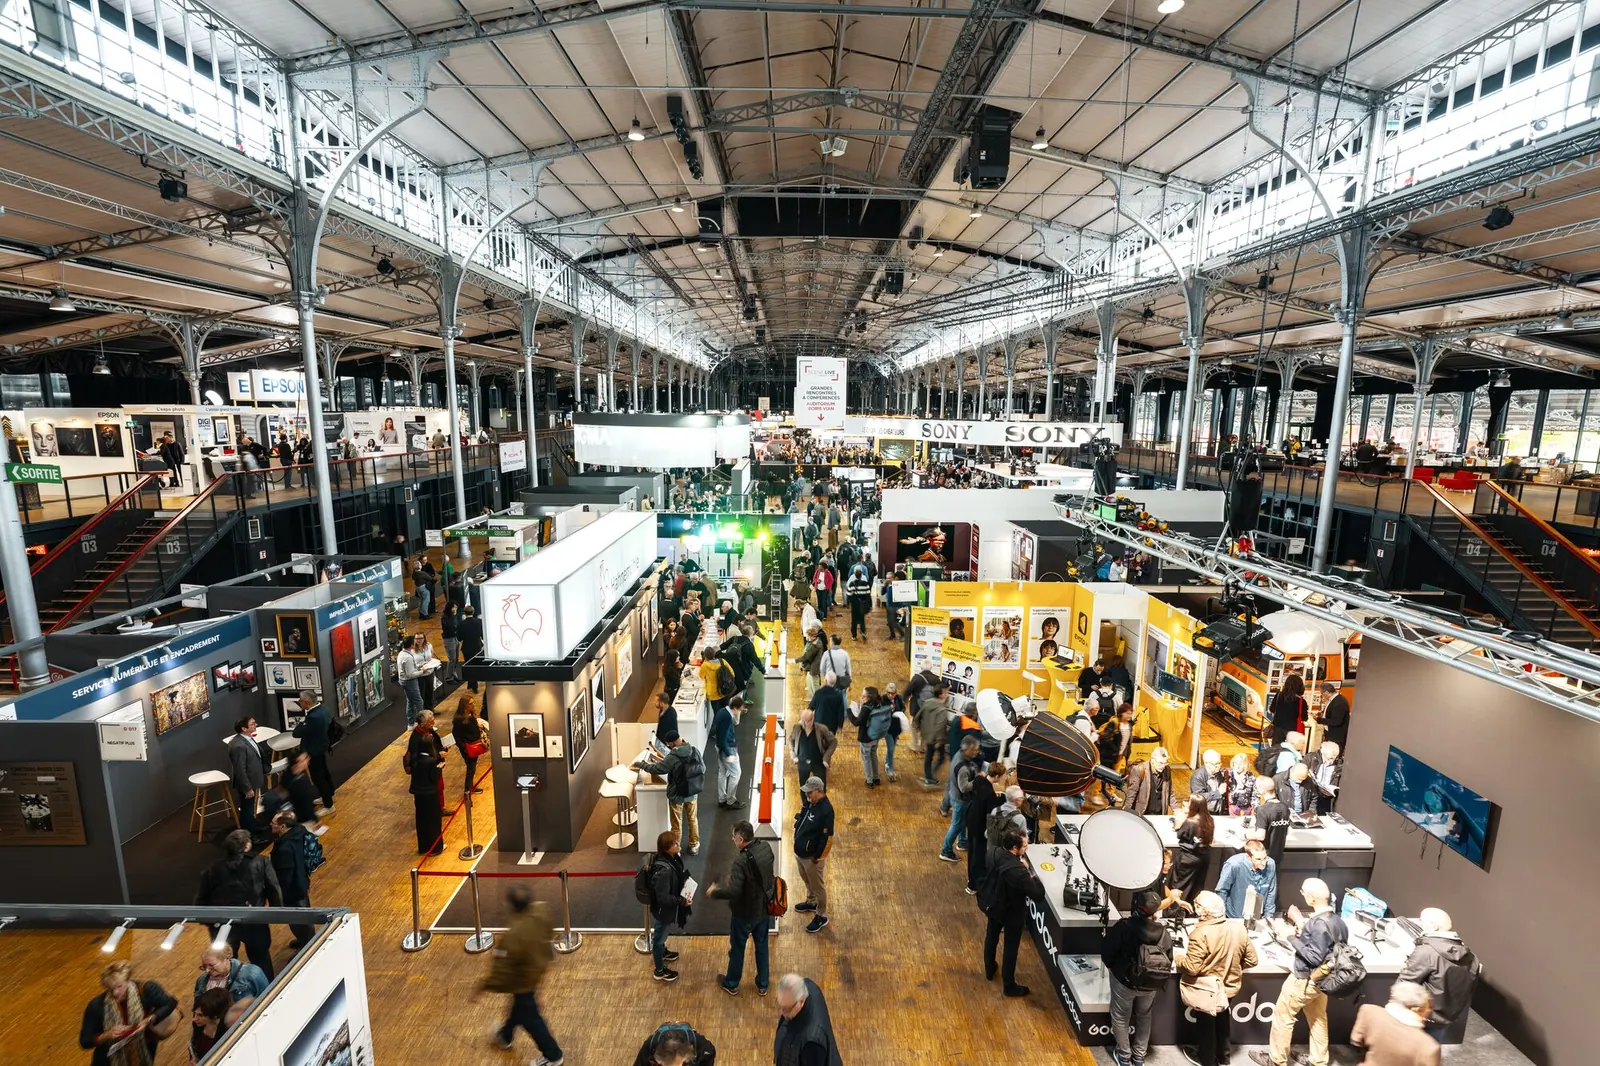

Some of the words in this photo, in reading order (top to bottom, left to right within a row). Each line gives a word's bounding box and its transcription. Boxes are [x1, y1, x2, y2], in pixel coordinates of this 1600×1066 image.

[262, 377, 305, 393] EPSON
[921, 422, 973, 440] SONY
[1005, 425, 1106, 443] SONY
[21, 467, 60, 480] SORTIE
[81, 540, 97, 554] 03
[166, 541, 181, 554] 03
[1466, 544, 1481, 556] 04
[1541, 544, 1556, 557] 04
[1250, 628, 1265, 639] odox
[72, 678, 110, 699] SERVICE
[159, 654, 169, 664] ET
[170, 634, 221, 660] ENCADREMENT
[1060, 984, 1081, 1031] Godox
